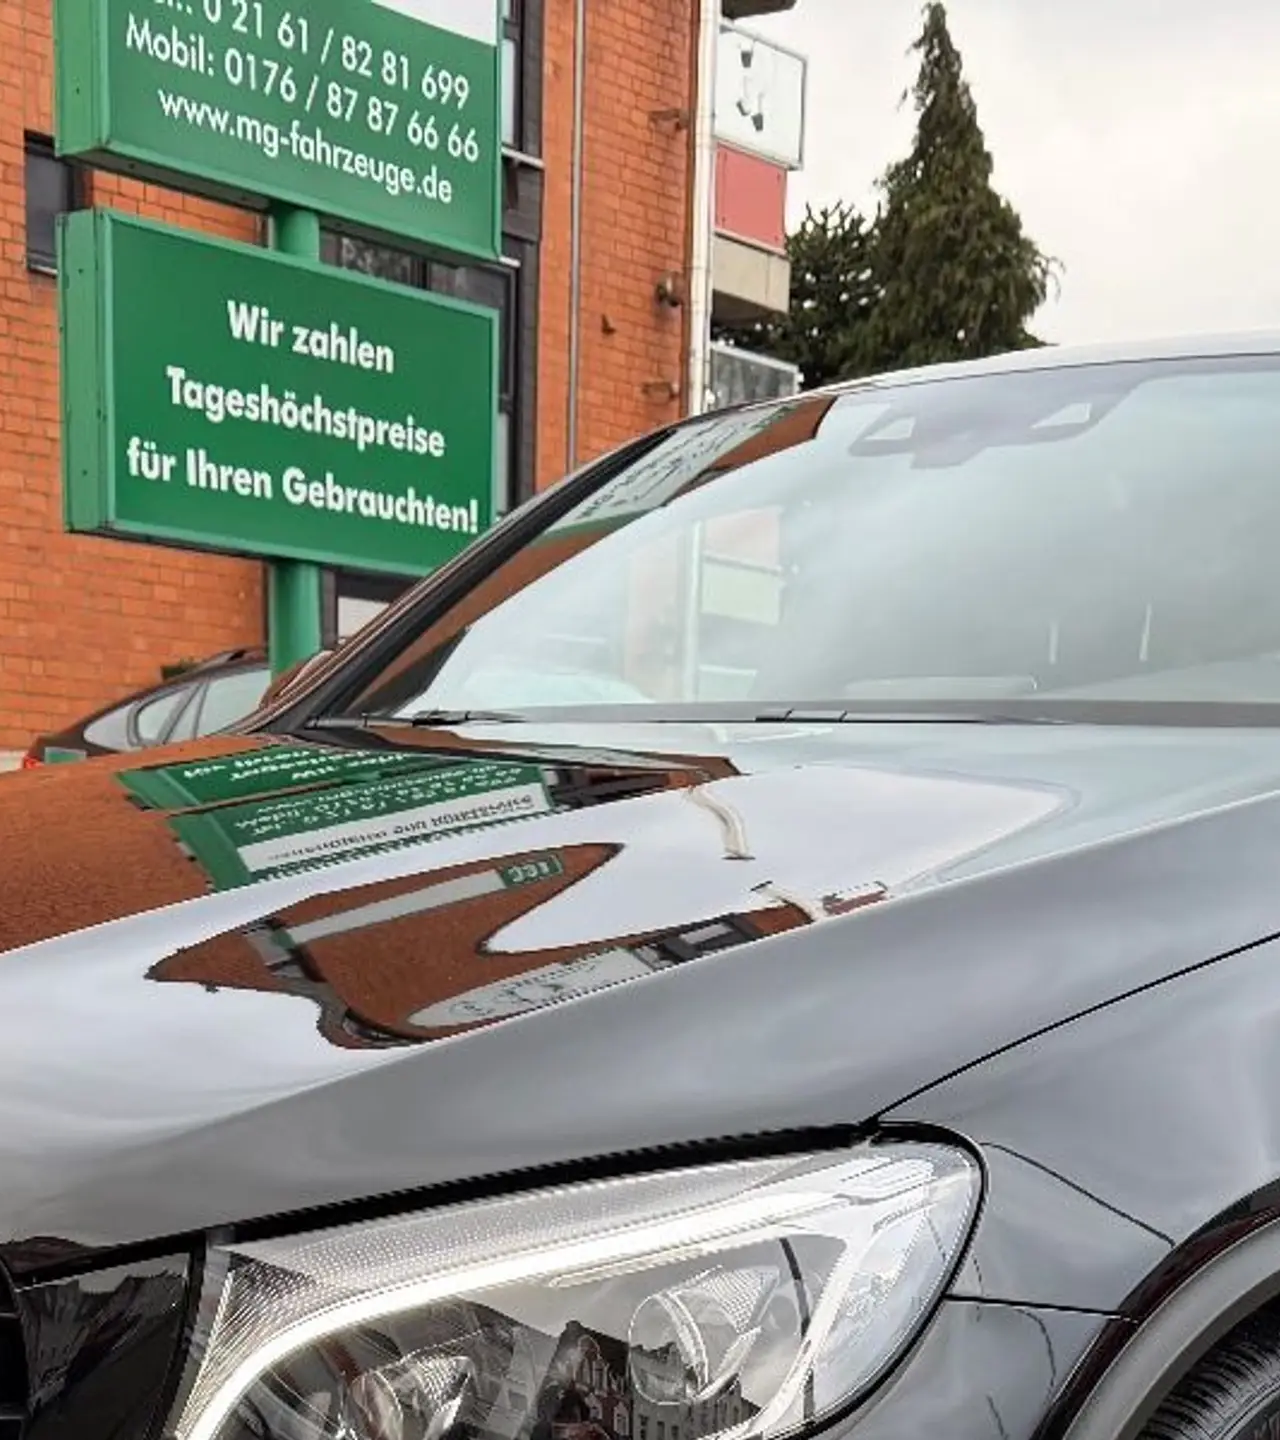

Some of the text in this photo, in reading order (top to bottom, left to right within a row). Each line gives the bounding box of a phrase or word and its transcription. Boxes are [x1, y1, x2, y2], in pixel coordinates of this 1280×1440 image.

[126, 11, 478, 163] Mobil: 0176 / 87 87 66 66
[231, 0, 262, 39] 21
[277, 12, 308, 54] 61
[320, 27, 334, 64] /
[342, 35, 372, 77] 82
[382, 50, 409, 90] 81
[422, 64, 469, 110] 699
[157, 88, 453, 204] www.mg-fahrzeuge.de
[227, 299, 394, 373] Wir zahlen
[166, 364, 446, 457] Tageshöchstpreise
[127, 436, 478, 534] für Ihren Gebrauchten!
